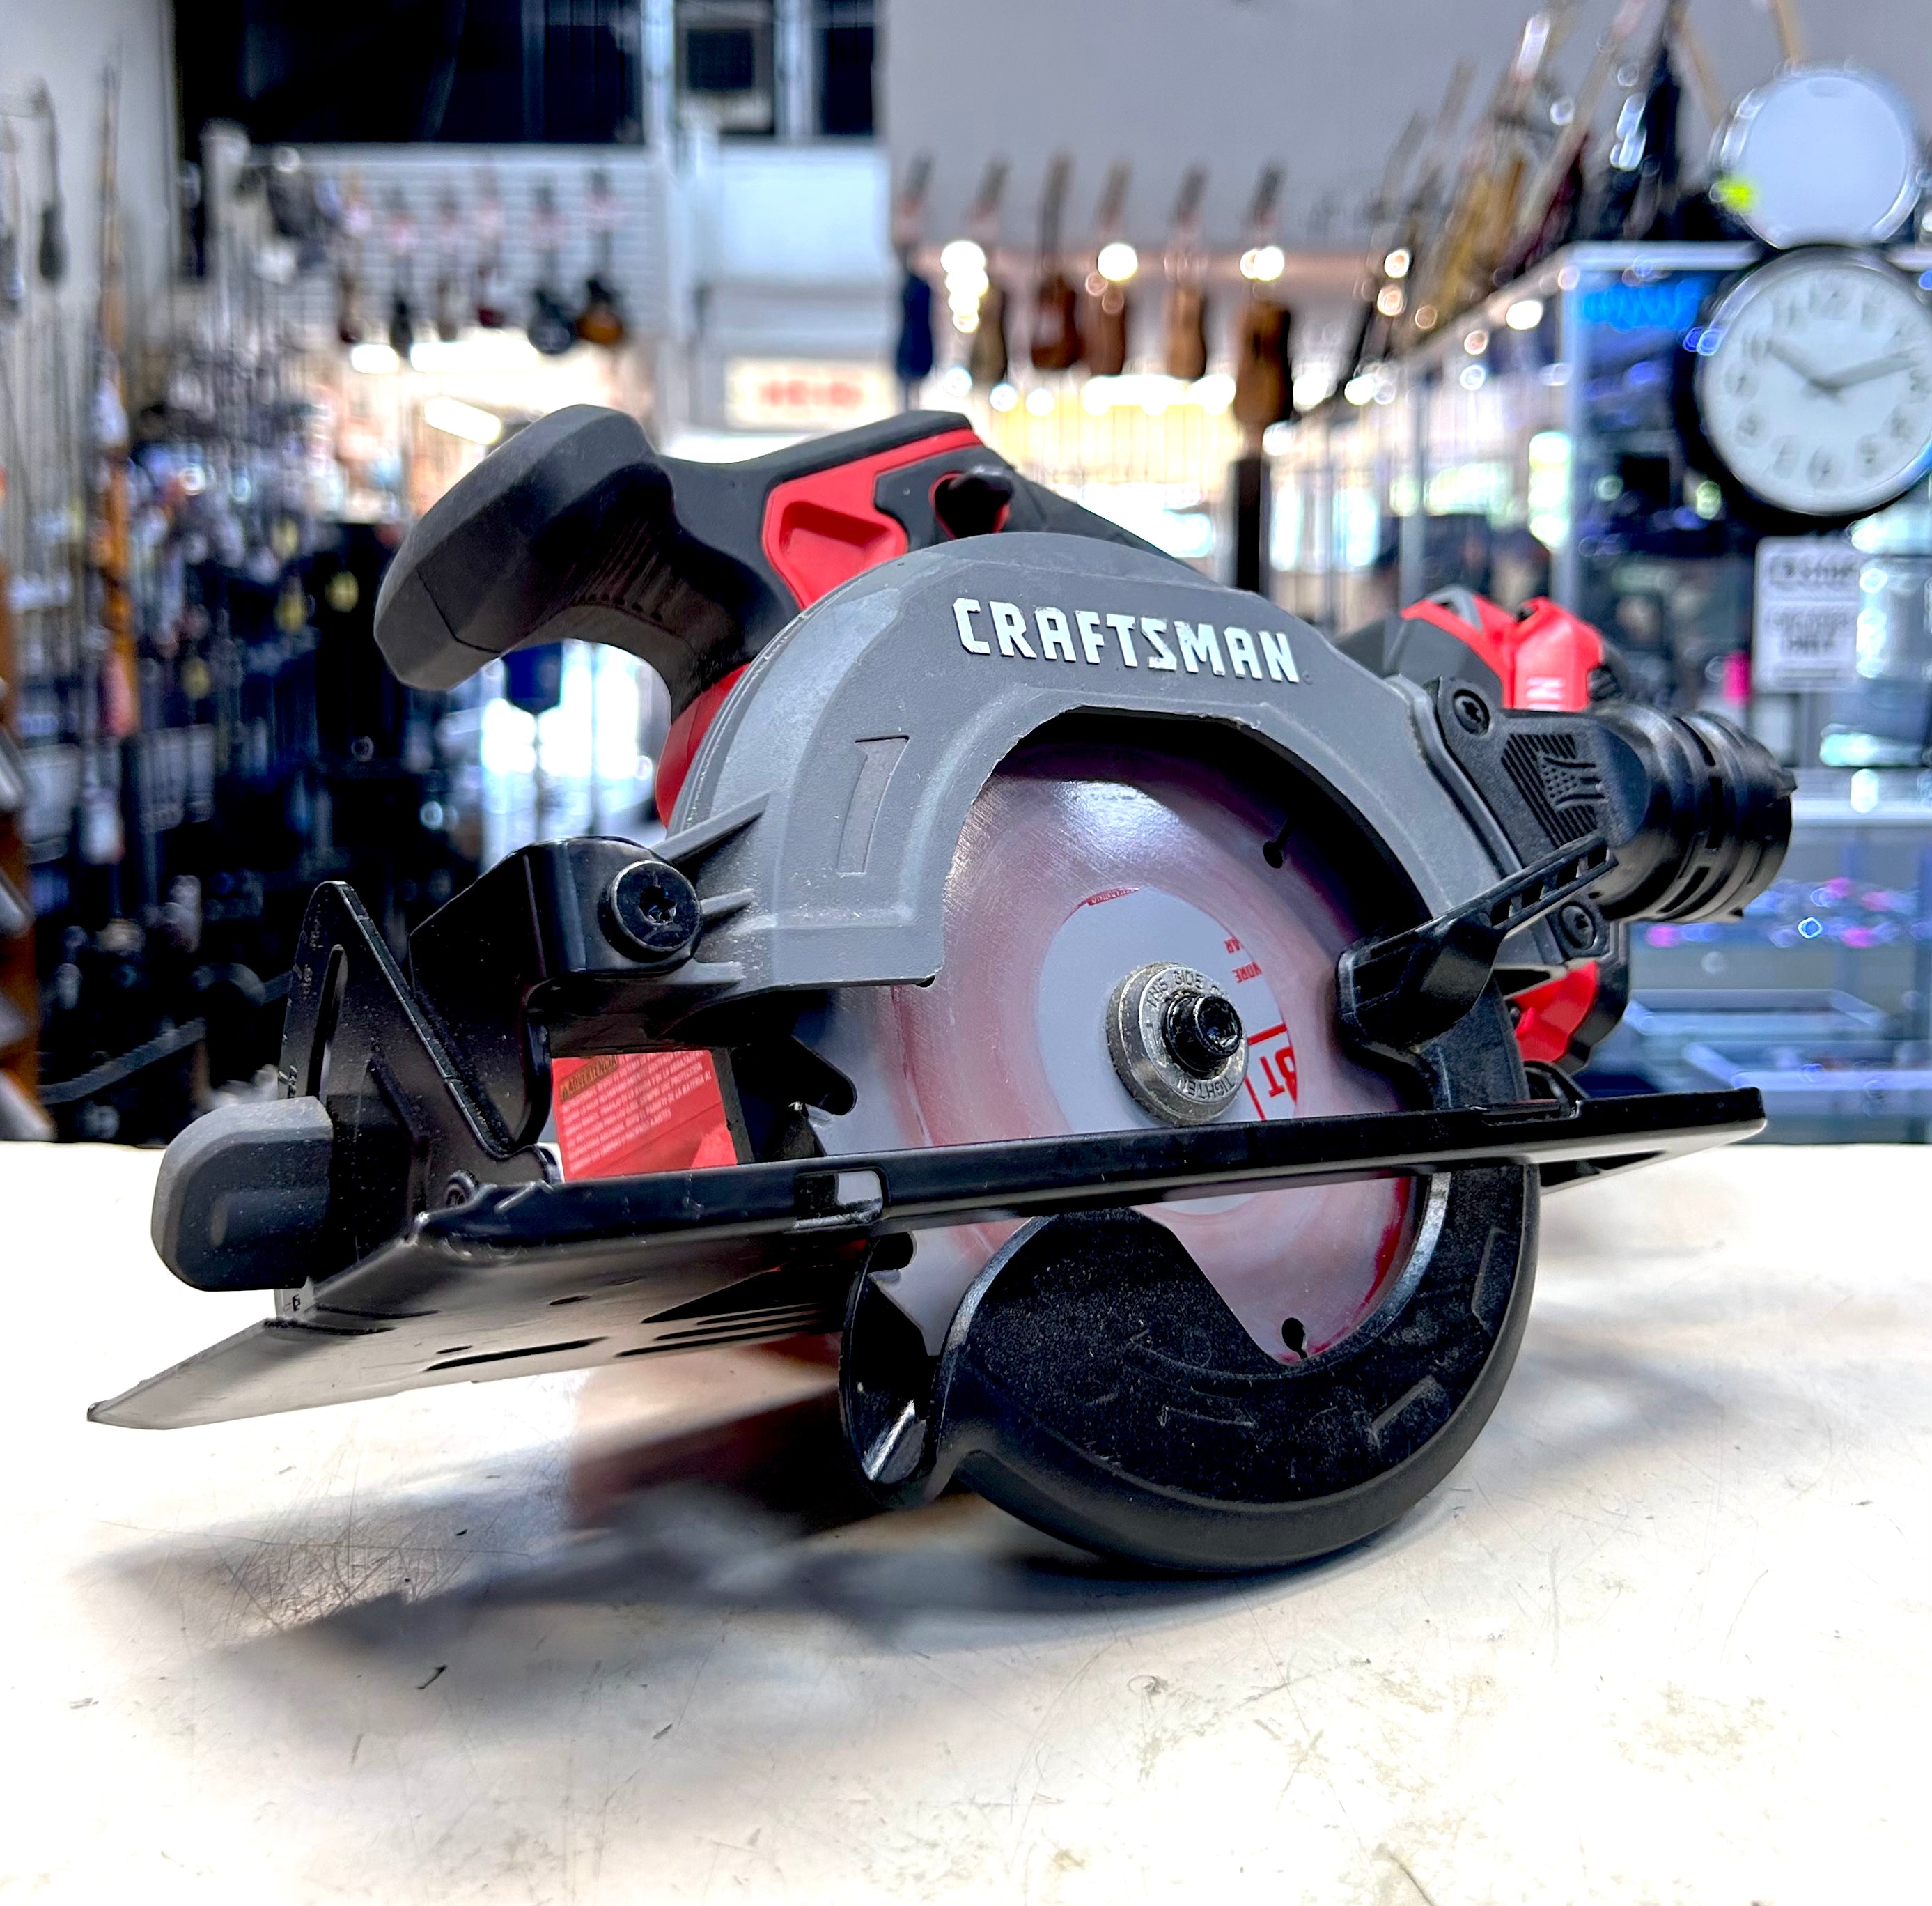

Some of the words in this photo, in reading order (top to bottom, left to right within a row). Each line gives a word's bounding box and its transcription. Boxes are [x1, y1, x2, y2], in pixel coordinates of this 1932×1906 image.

[953, 598, 1299, 683] CRAFTSMAN
[1147, 977, 1168, 1007] THIS
[1174, 970, 1205, 990] SIDE
[1177, 1076, 1236, 1099] TIGHTEN
